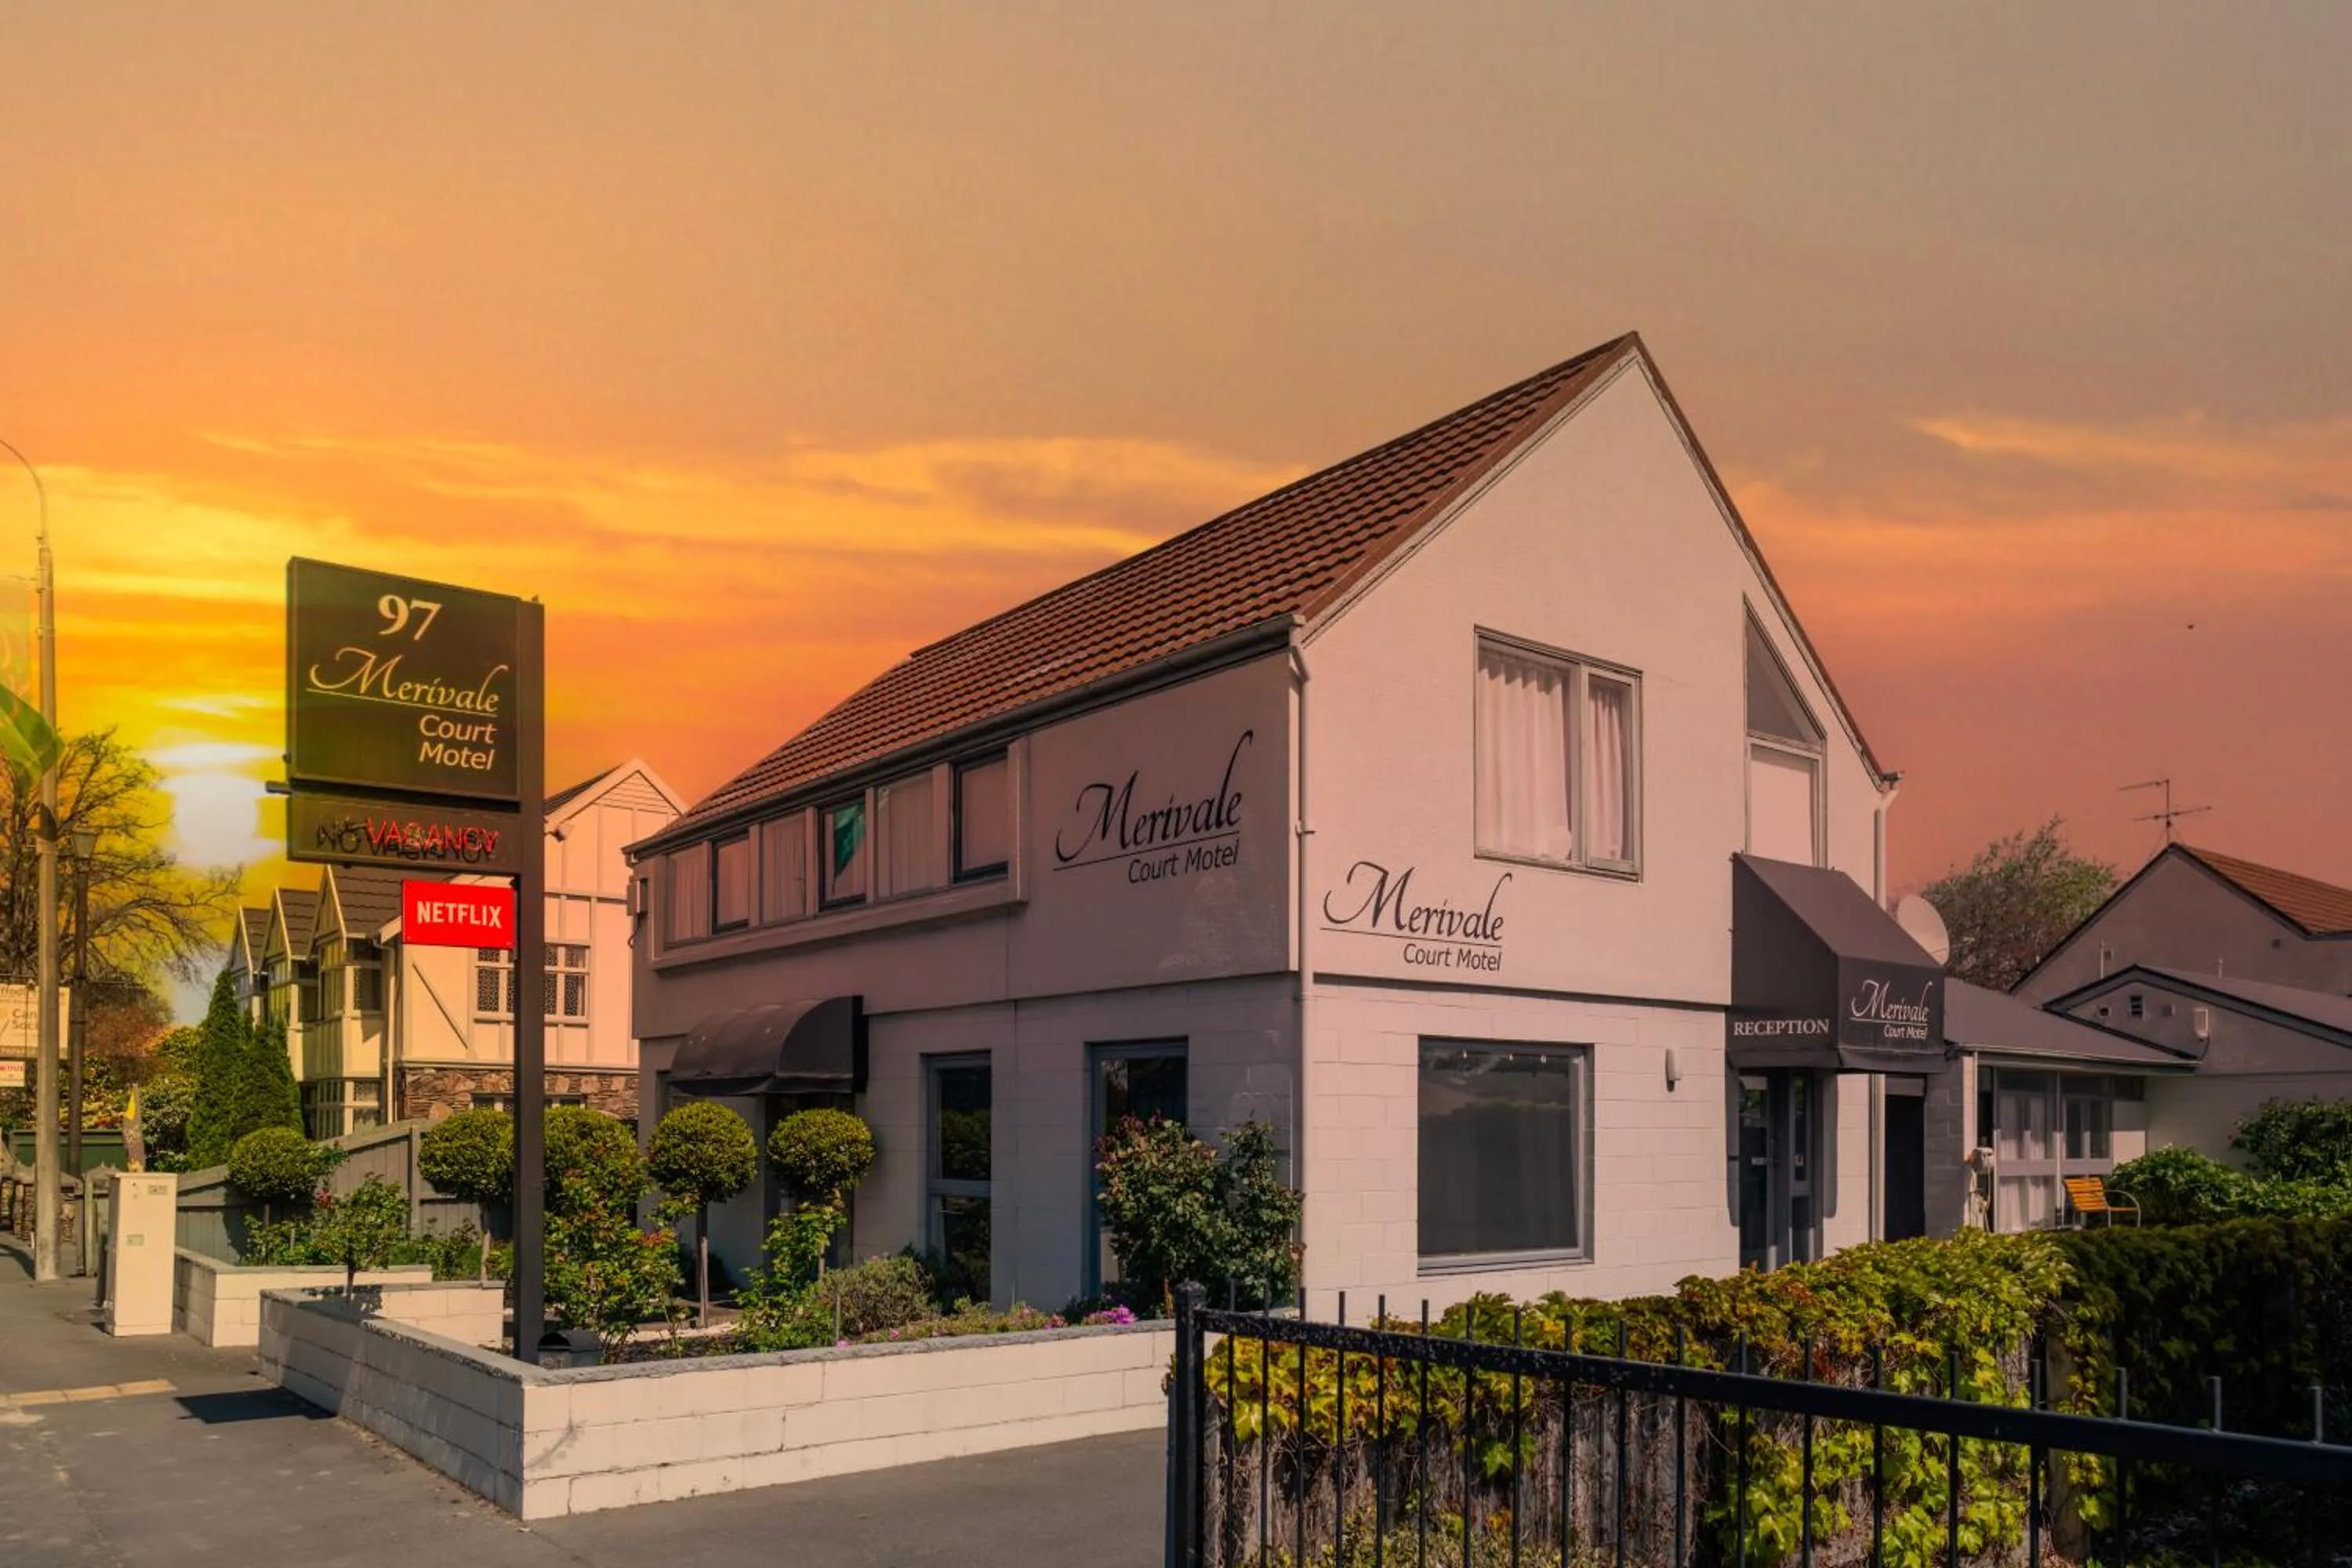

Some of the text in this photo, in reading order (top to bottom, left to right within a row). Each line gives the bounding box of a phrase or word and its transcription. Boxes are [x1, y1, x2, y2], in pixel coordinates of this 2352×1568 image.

[379, 594, 441, 640] 97
[310, 647, 508, 713] Merivale
[419, 715, 496, 744] Court
[419, 741, 495, 771] Motel
[1056, 730, 1253, 861] Merivale
[365, 816, 500, 853] VACANCY
[1128, 840, 1240, 884] Court Motel
[416, 901, 503, 928] NETFLIX
[1323, 862, 1512, 942] Merivale
[1403, 943, 1501, 971] Court Motel
[1850, 980, 1932, 1022] Merivale
[1733, 1018, 1829, 1036] RECEPTION
[1884, 1025, 1928, 1039] Court Motel
